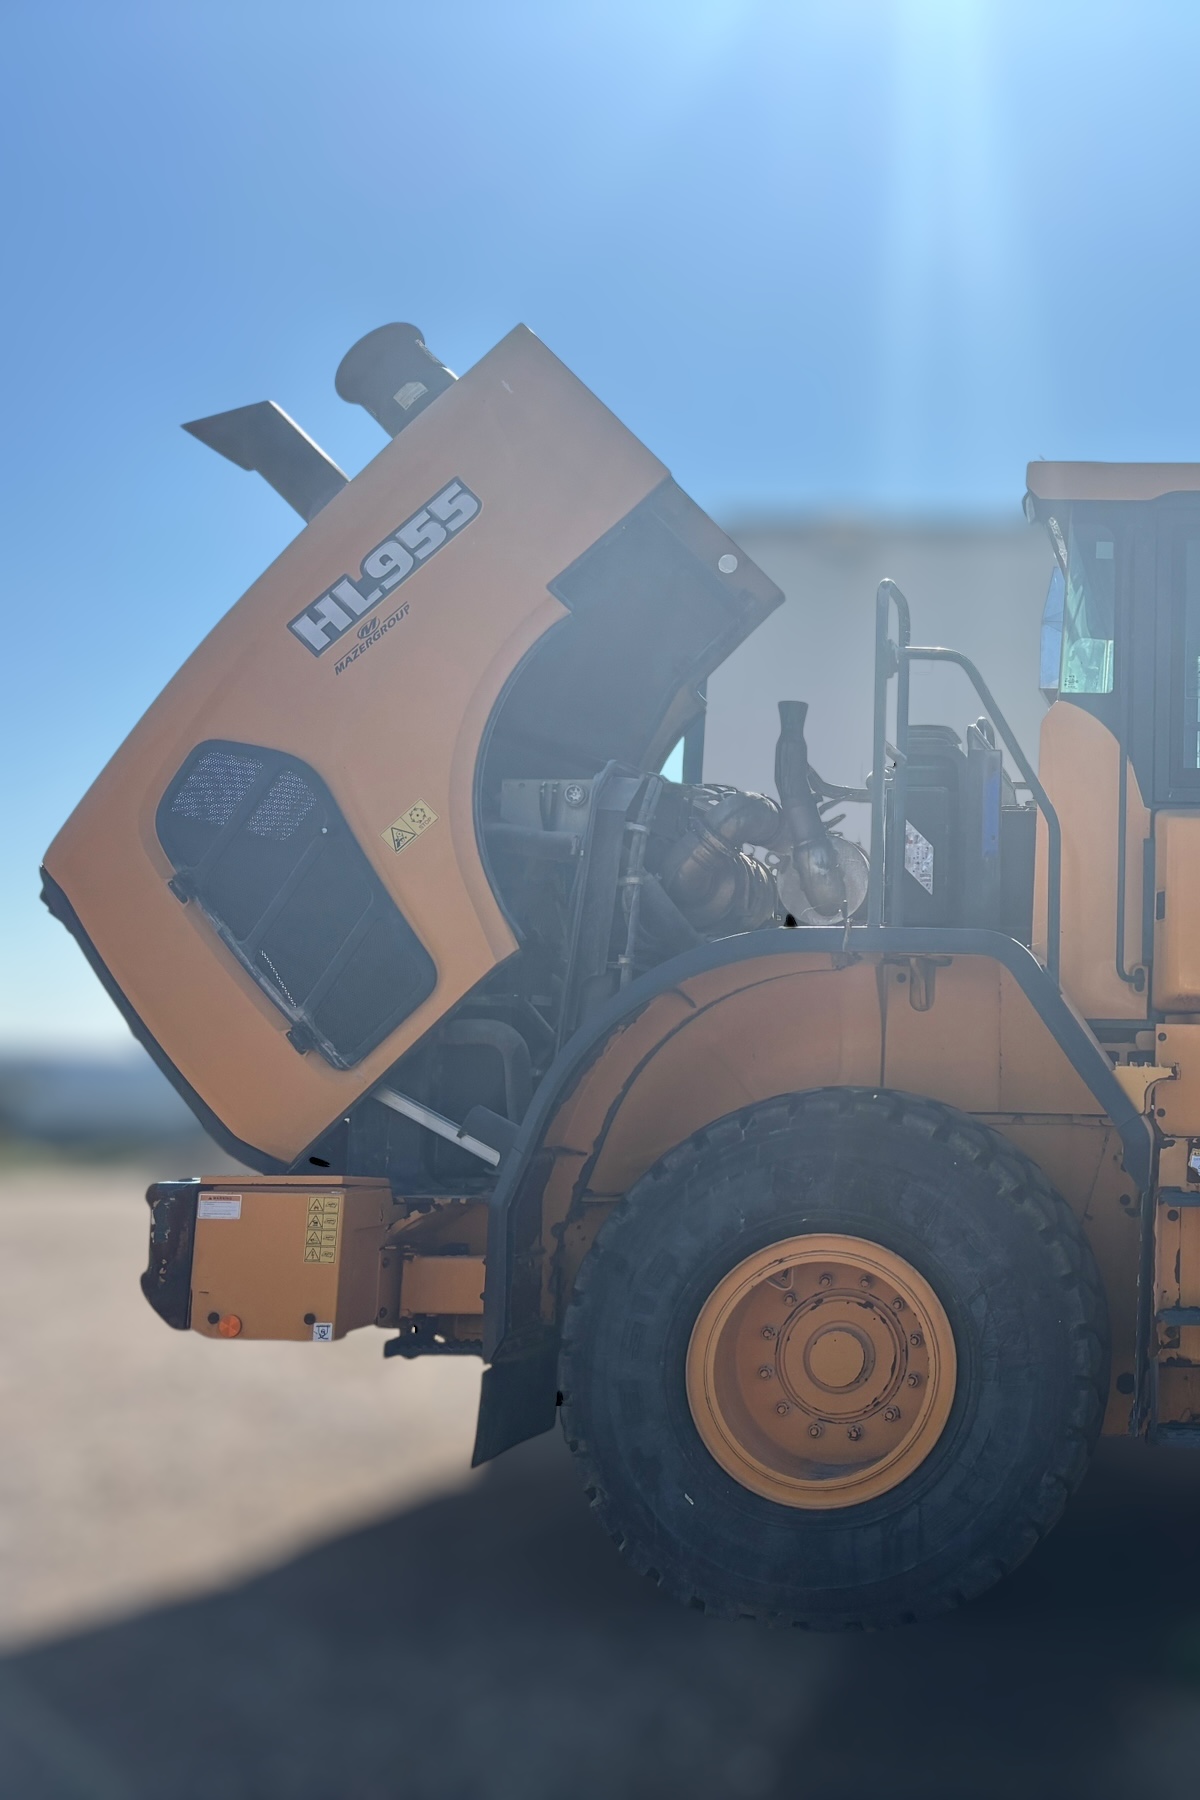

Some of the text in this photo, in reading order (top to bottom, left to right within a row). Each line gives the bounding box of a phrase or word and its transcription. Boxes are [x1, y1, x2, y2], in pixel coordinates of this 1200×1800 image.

[292, 482, 479, 651] HL955
[334, 603, 410, 676] MAZERGROUP
[418, 816, 431, 829] STOP
